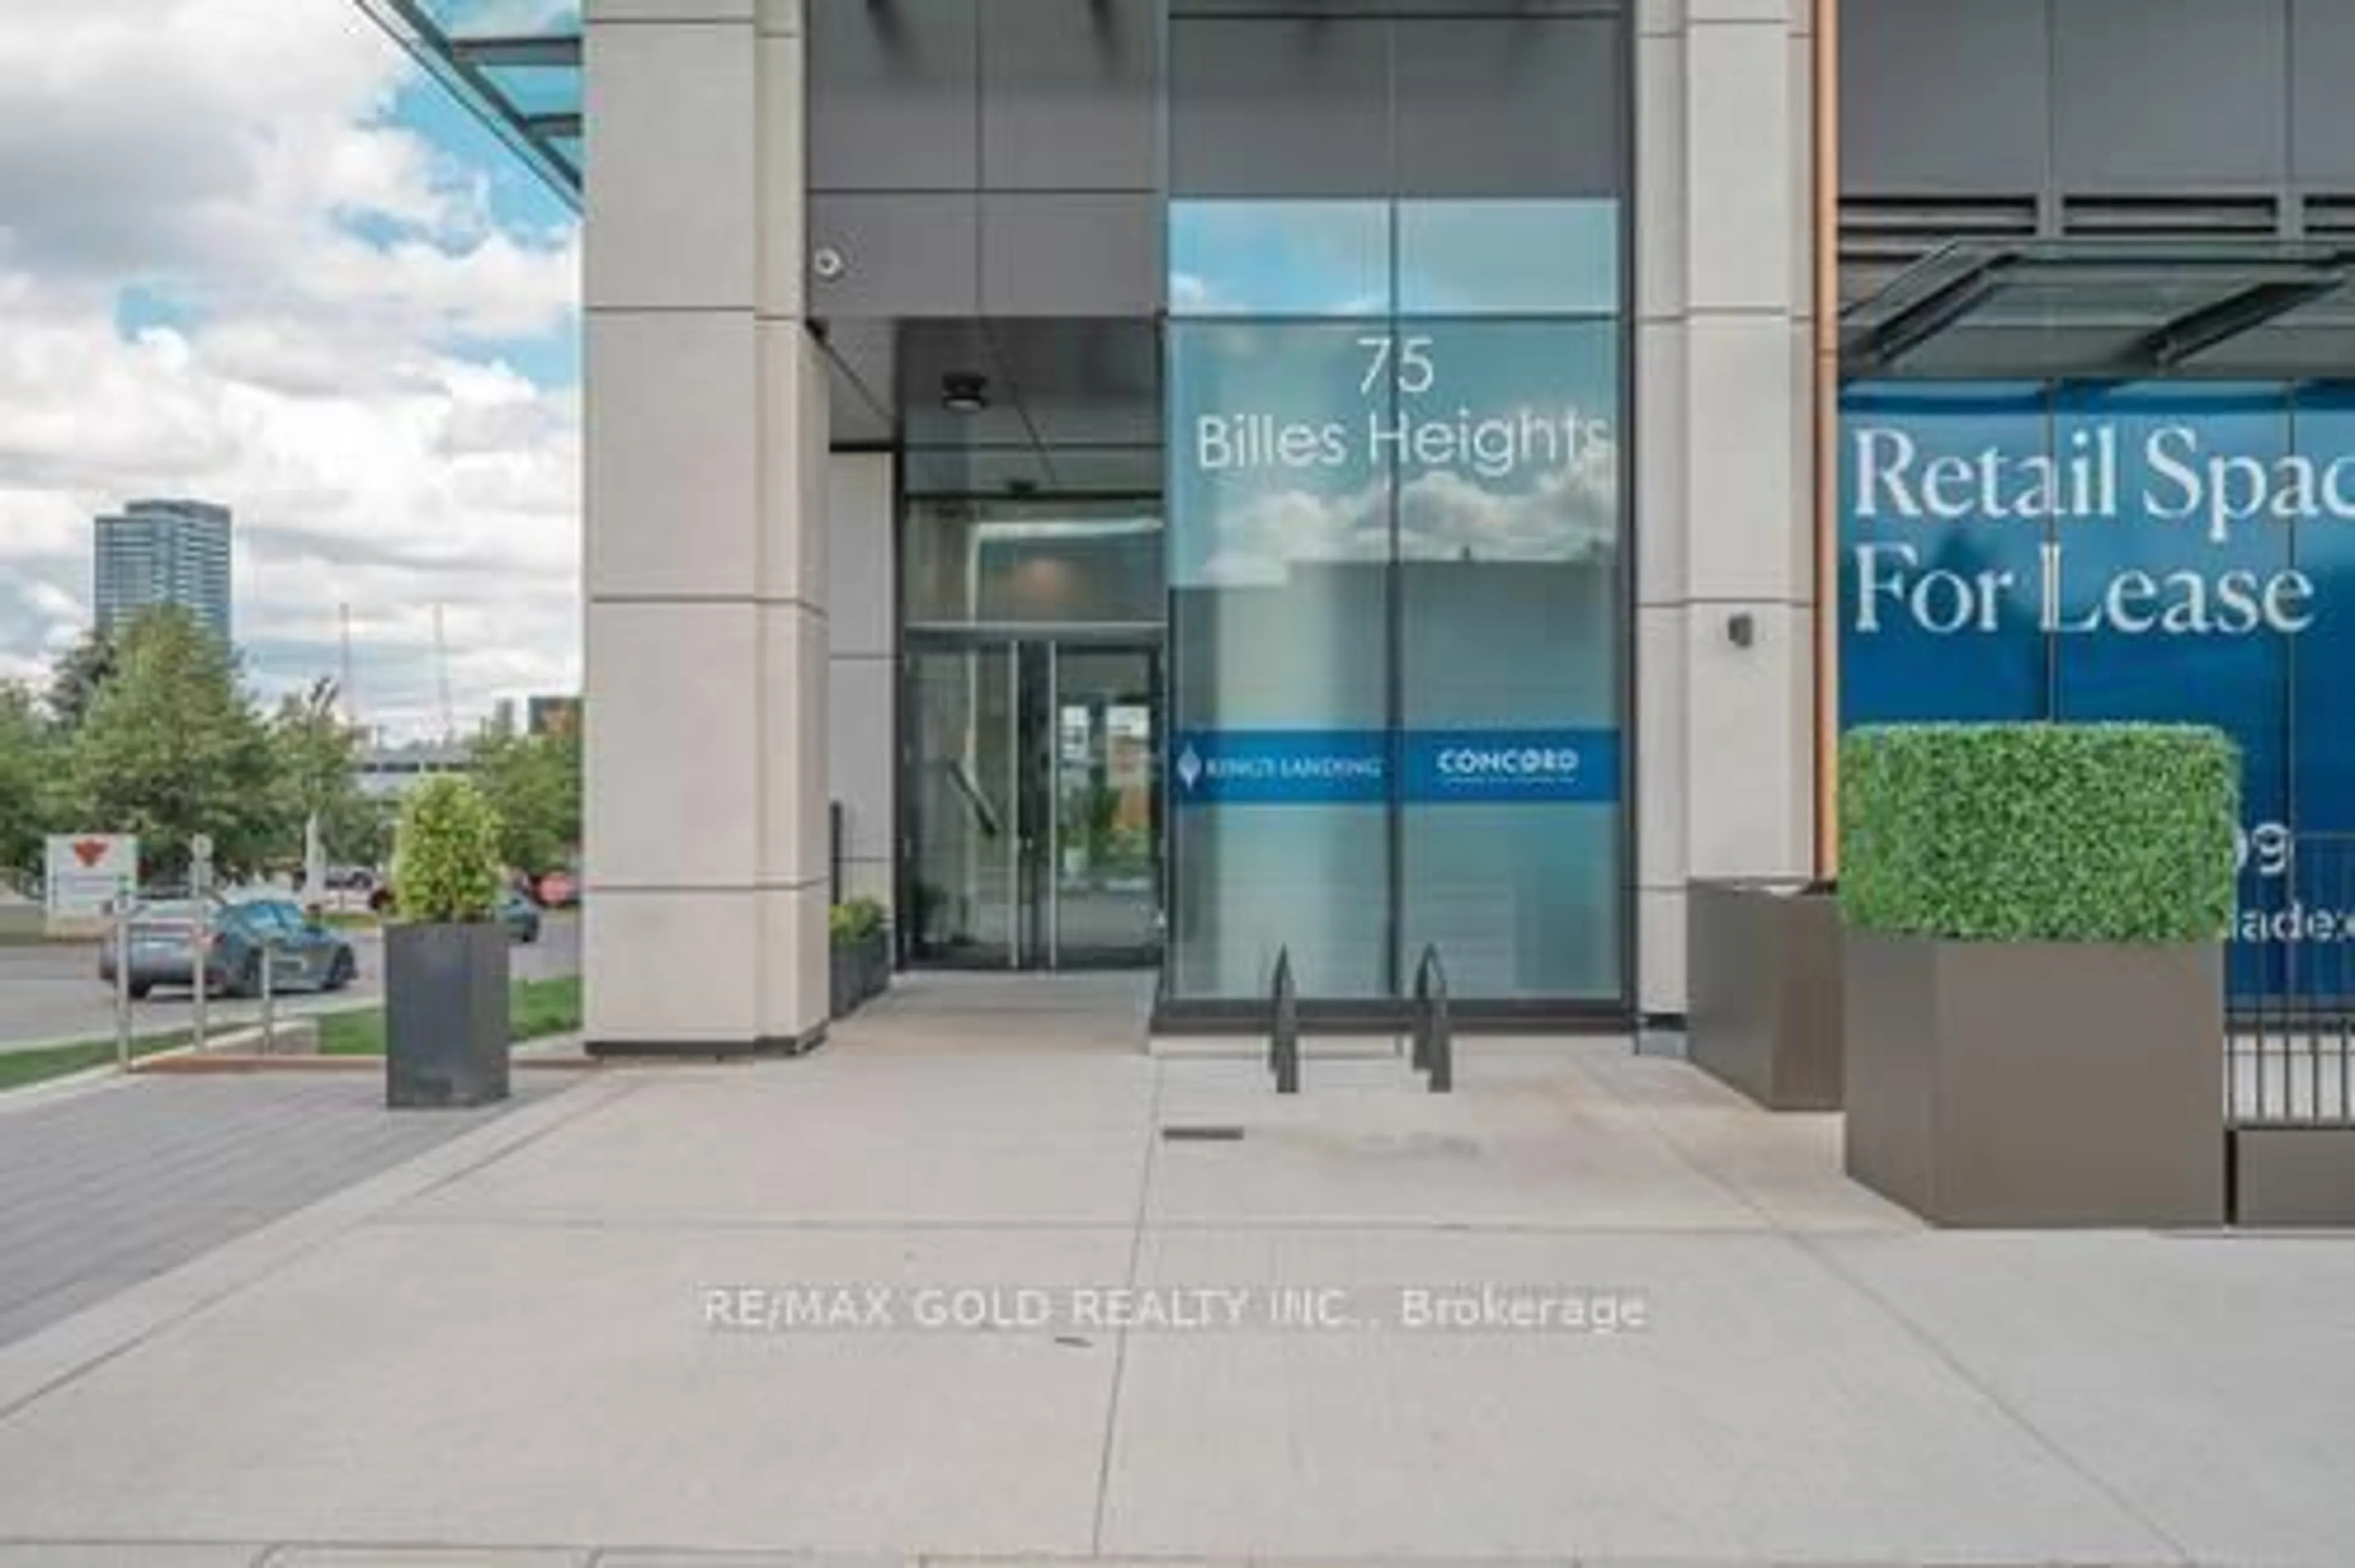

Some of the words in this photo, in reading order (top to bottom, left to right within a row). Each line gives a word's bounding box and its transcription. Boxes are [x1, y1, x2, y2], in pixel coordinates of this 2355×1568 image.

[1356, 337, 1434, 394] 75
[1197, 414, 1347, 469] Billes
[1369, 406, 1612, 478] Heights
[1854, 423, 2116, 518] Retail
[1855, 541, 2015, 633] For
[2039, 541, 2316, 634] Lease
[1435, 746, 1580, 774] CONCORD
